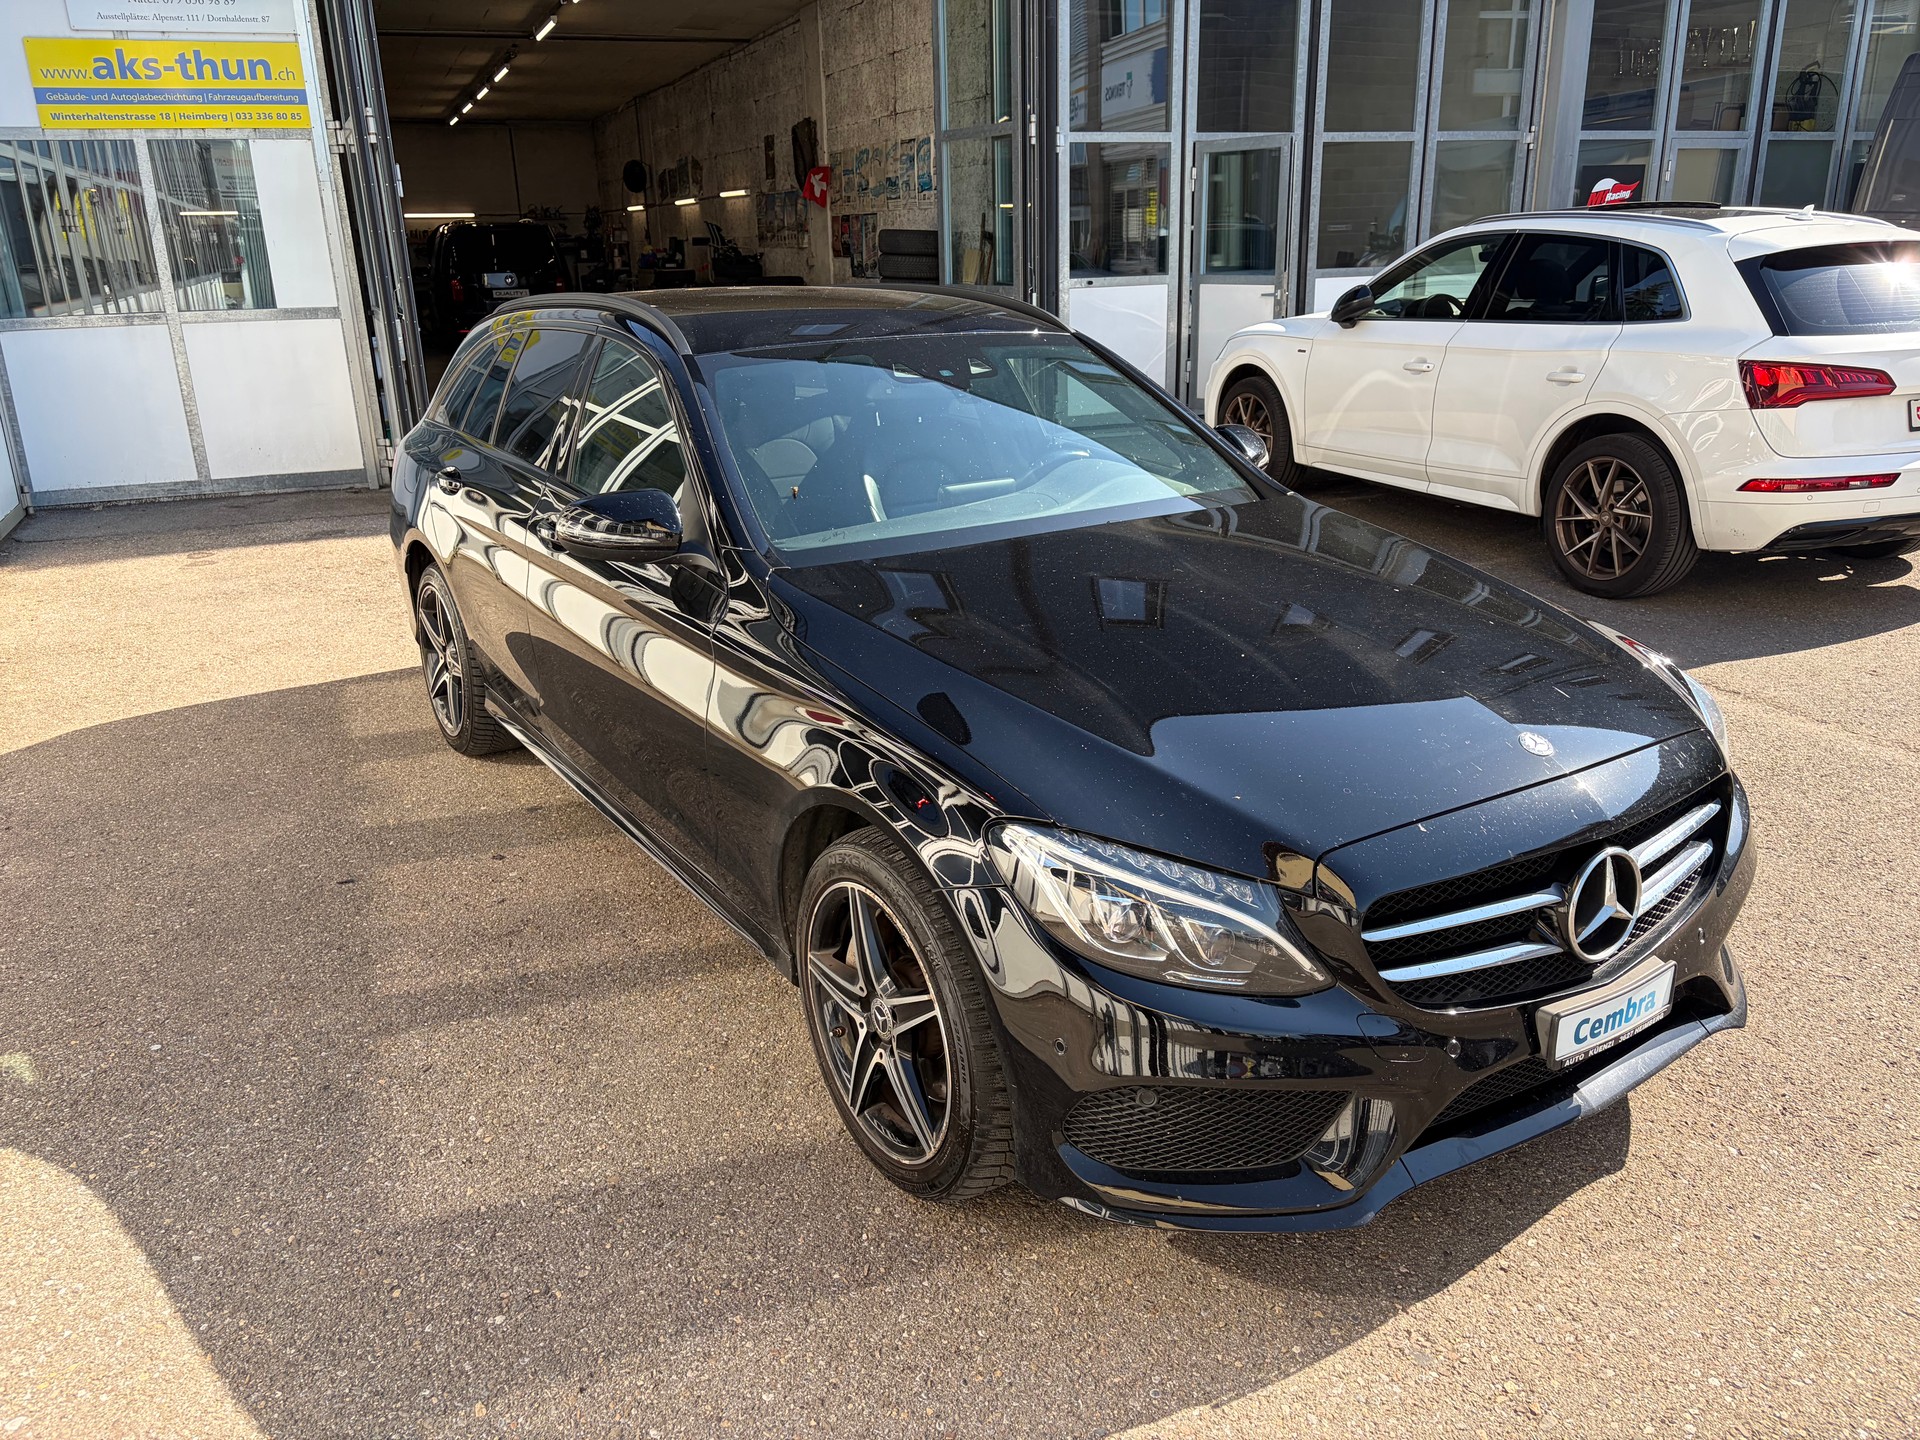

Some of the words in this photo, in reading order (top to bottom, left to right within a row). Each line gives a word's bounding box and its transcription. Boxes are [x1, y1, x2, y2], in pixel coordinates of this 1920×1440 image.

[96, 12, 150, 22] Ausstellplätze:
[152, 13, 186, 23] Alpenstr.
[186, 14, 200, 22] 111
[261, 15, 271, 23] 87
[39, 48, 297, 81] www.aks-thun.ch
[45, 92, 90, 102] Gebäude-
[93, 92, 109, 101] und
[110, 92, 203, 103] Autoglasbeschichtung
[208, 93, 299, 104] Fahrzeugaufbereitung
[49, 111, 156, 121] Winterhaltenstrasse
[159, 112, 171, 121] 18
[179, 112, 228, 122] Heimberg
[235, 112, 253, 121] 033
[256, 112, 274, 121] 336
[276, 112, 288, 121] 80
[290, 112, 302, 121] 85
[1606, 190, 1632, 201] Racing
[1573, 990, 1656, 1046] Cembra
[1564, 1053, 1585, 1067] AUTO
